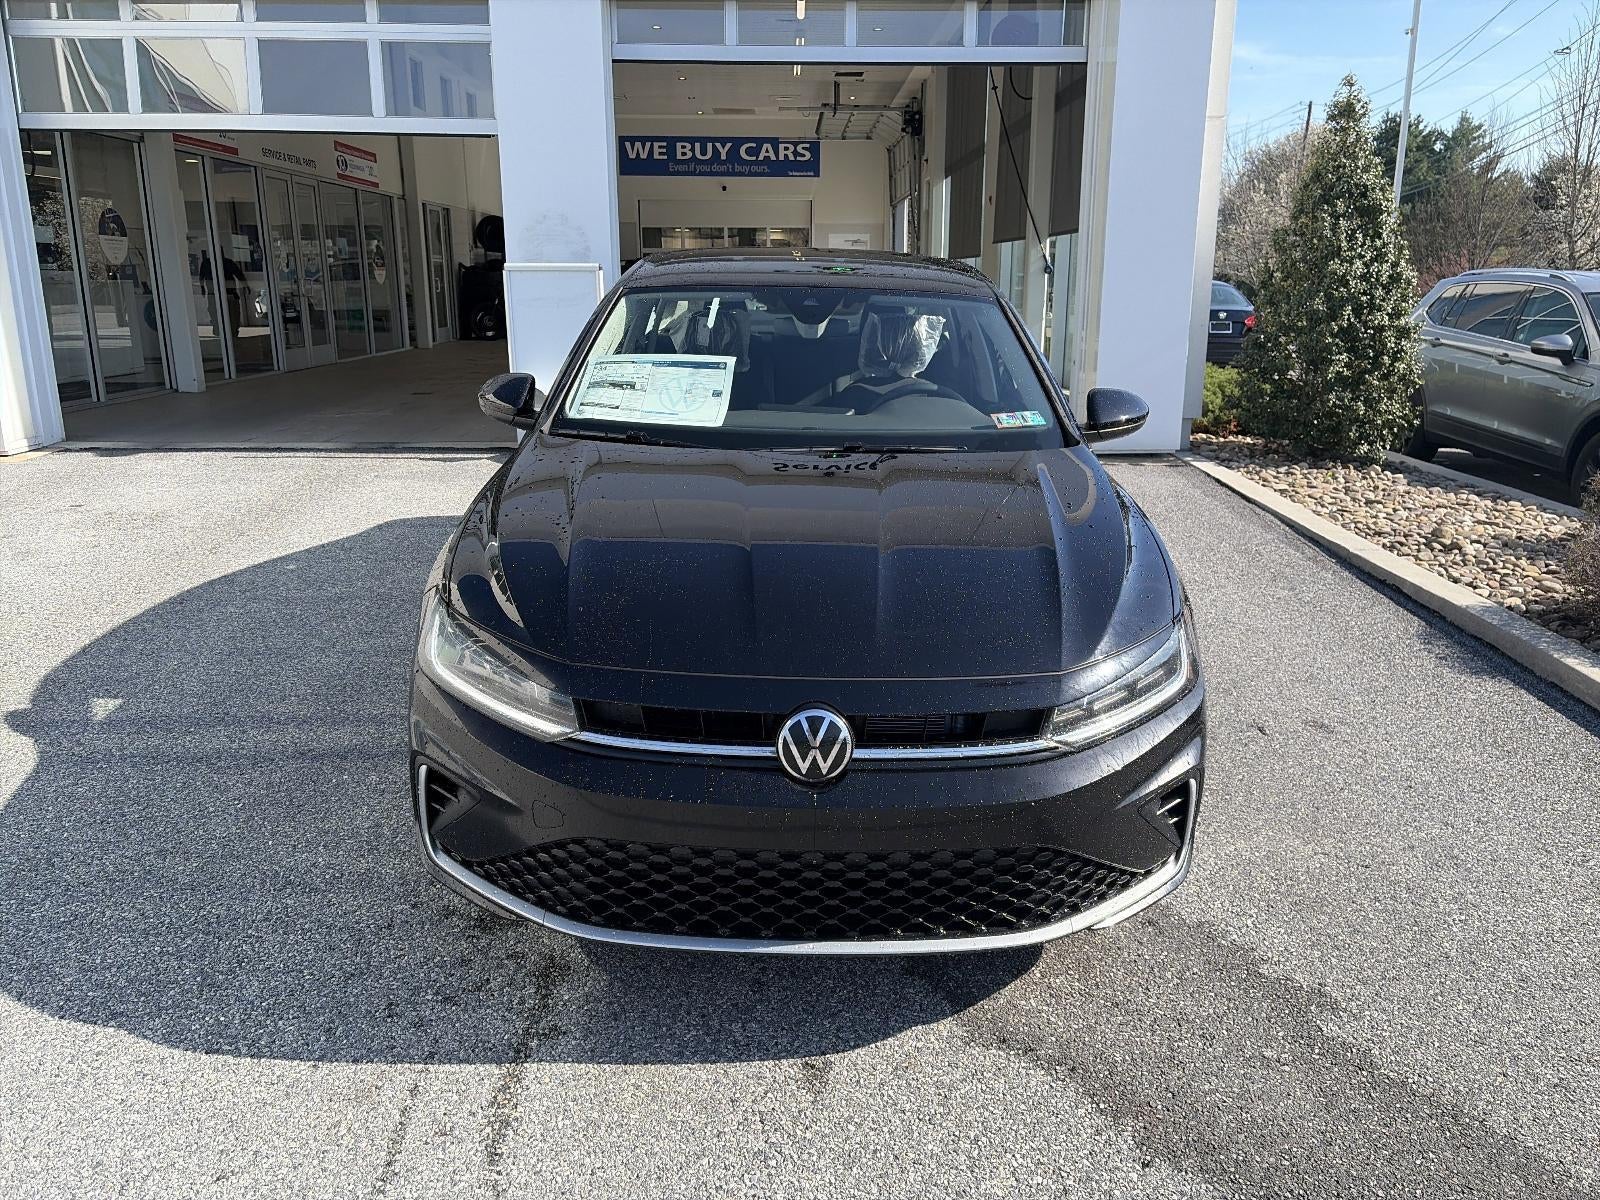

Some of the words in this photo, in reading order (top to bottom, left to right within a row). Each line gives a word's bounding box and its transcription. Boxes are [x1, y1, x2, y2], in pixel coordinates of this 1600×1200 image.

[261, 146, 282, 161] SERVICE
[282, 152, 287, 162] &
[287, 153, 302, 166] RETAIL
[303, 157, 317, 170] PARTS
[624, 141, 668, 160] WE
[676, 142, 733, 160] BUY
[668, 162, 688, 172] Even
[689, 162, 695, 172] if
[695, 163, 710, 174] you
[711, 162, 732, 172] don't
[735, 162, 750, 174] buy
[751, 164, 770, 173] ours.
[778, 709, 852, 782] VW
